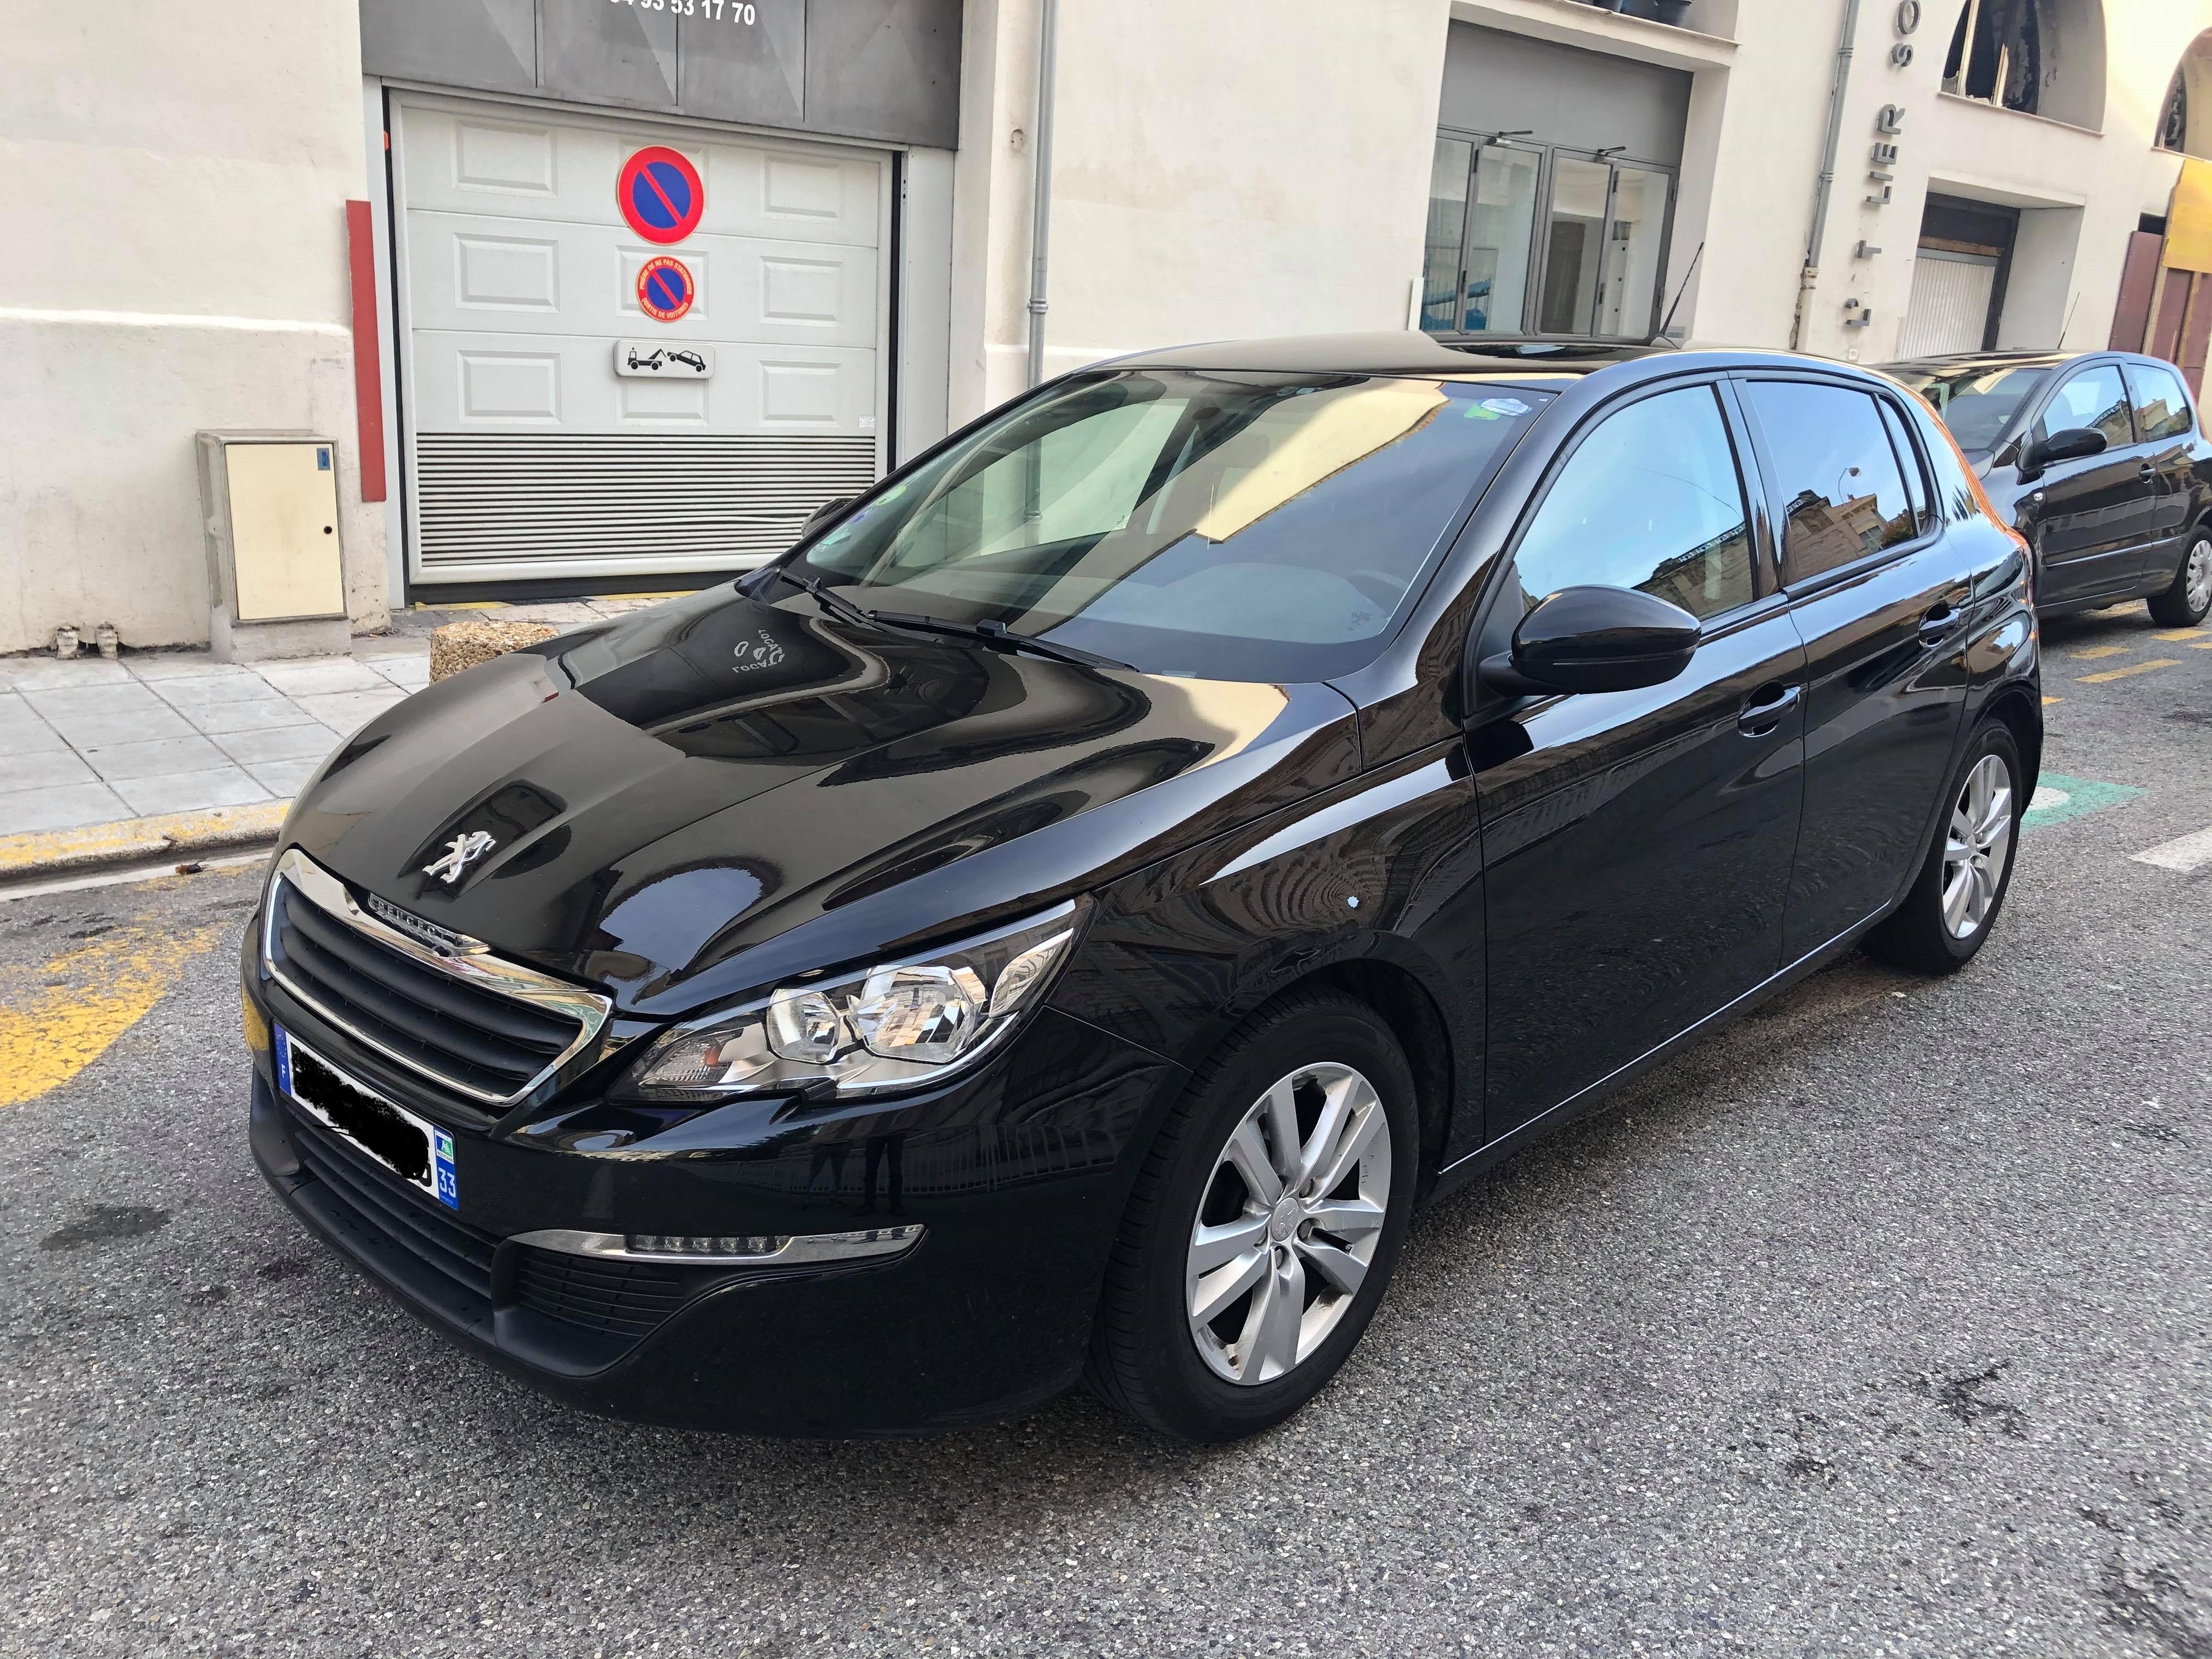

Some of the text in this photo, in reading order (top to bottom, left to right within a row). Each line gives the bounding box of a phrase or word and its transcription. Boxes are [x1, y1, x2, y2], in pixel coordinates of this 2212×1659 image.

[702, 0, 725, 20] 17
[732, 2, 755, 26] 70
[647, 262, 656, 271] DE
[663, 258, 674, 267] PAS
[674, 262, 692, 295] STATIONNER
[642, 297, 657, 315] SORTIE
[666, 301, 689, 319] VOITURES
[377, 899, 445, 940] PEUGEOT
[281, 1063, 286, 1079] F
[438, 1167, 456, 1198] 33
